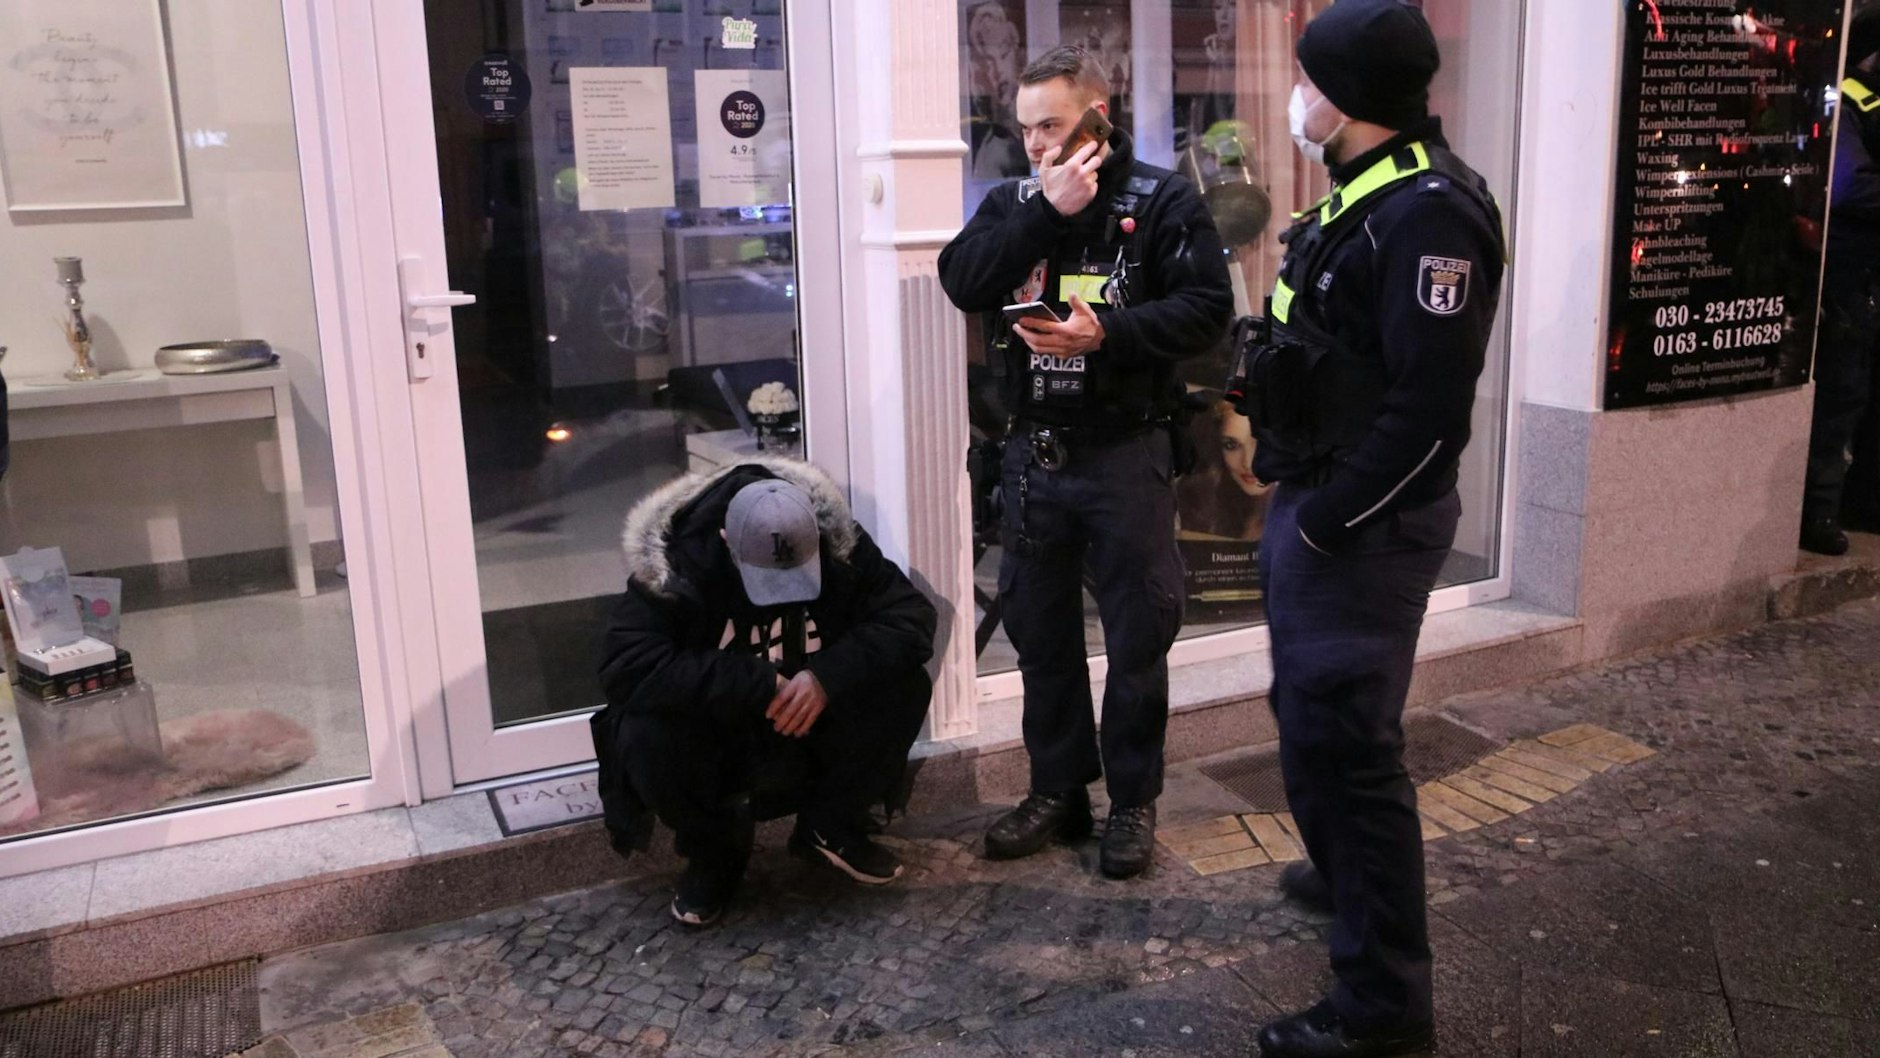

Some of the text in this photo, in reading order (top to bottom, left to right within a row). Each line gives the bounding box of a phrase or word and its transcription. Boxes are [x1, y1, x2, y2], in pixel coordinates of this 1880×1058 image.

[1646, 13, 1702, 26] Kassische
[723, 31, 752, 43] Vida
[1672, 30, 1704, 46] Aging
[1643, 47, 1749, 63] Luxusbehandlungen
[490, 67, 509, 79] Top
[1642, 64, 1777, 81] Luxus Gold Behandlungen
[483, 76, 512, 86] Rated
[1640, 82, 1659, 95] Ice
[1660, 81, 1686, 95] trifft
[1689, 81, 1714, 95] Gold
[1717, 82, 1748, 94] Luxus
[736, 100, 756, 113] Top
[1640, 99, 1657, 112] Ice
[1660, 99, 1685, 112] Well
[727, 110, 758, 121] Rated
[1638, 115, 1746, 133] Kombibehandlungen
[1667, 134, 1693, 147] SHR
[1695, 133, 1713, 146] mit
[1636, 152, 1679, 167] Waxing
[1634, 184, 1716, 201] Wimpernlifting
[1634, 202, 1724, 217] Unterspritzungen
[1632, 217, 1682, 233] Make UP
[1631, 234, 1708, 250] Zahnbleaching
[1423, 257, 1468, 273] POLIZEI
[1630, 267, 1681, 283] Maniküre
[1689, 265, 1734, 279] Pediküre
[1629, 284, 1690, 301] Schulungen
[1655, 305, 1689, 329] 030
[1704, 295, 1785, 324] 23473745
[1653, 331, 1698, 357] 0163
[1713, 322, 1783, 350] 6116628
[1030, 354, 1085, 373] POLIZEI
[1671, 355, 1766, 376] Online Terminbuchung
[1052, 380, 1080, 390] BFZ
[770, 532, 796, 561] LA
[1211, 552, 1249, 563] Diamant
